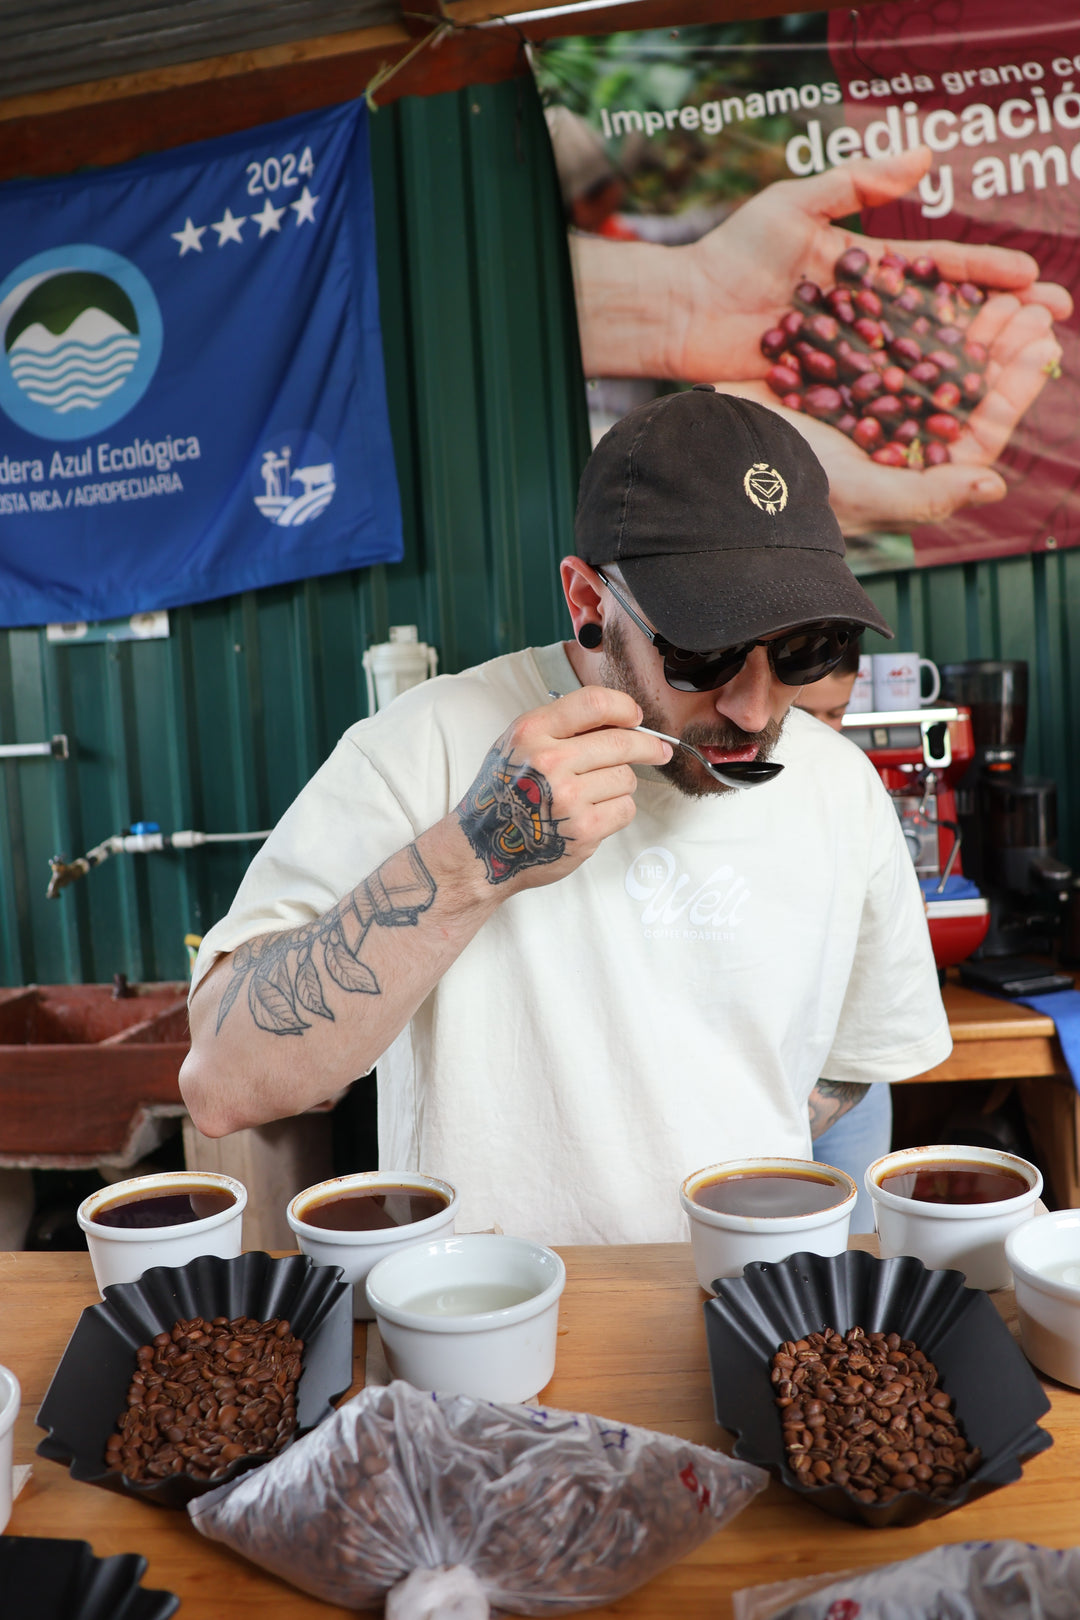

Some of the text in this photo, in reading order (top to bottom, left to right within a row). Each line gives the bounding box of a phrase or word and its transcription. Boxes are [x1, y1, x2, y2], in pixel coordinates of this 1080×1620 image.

[600, 82, 842, 139] Impregnamos
[849, 72, 935, 99] cada
[941, 61, 1045, 95] grano
[785, 81, 1080, 176] dedicació
[246, 146, 315, 196] 2024
[919, 164, 953, 218] y
[50, 446, 93, 480] Azul
[97, 434, 201, 472] Ecológica
[29, 489, 63, 512] RICA
[74, 472, 184, 508] AGROPECUARIA
[624, 846, 752, 927] Well
[638, 864, 663, 880] THE
